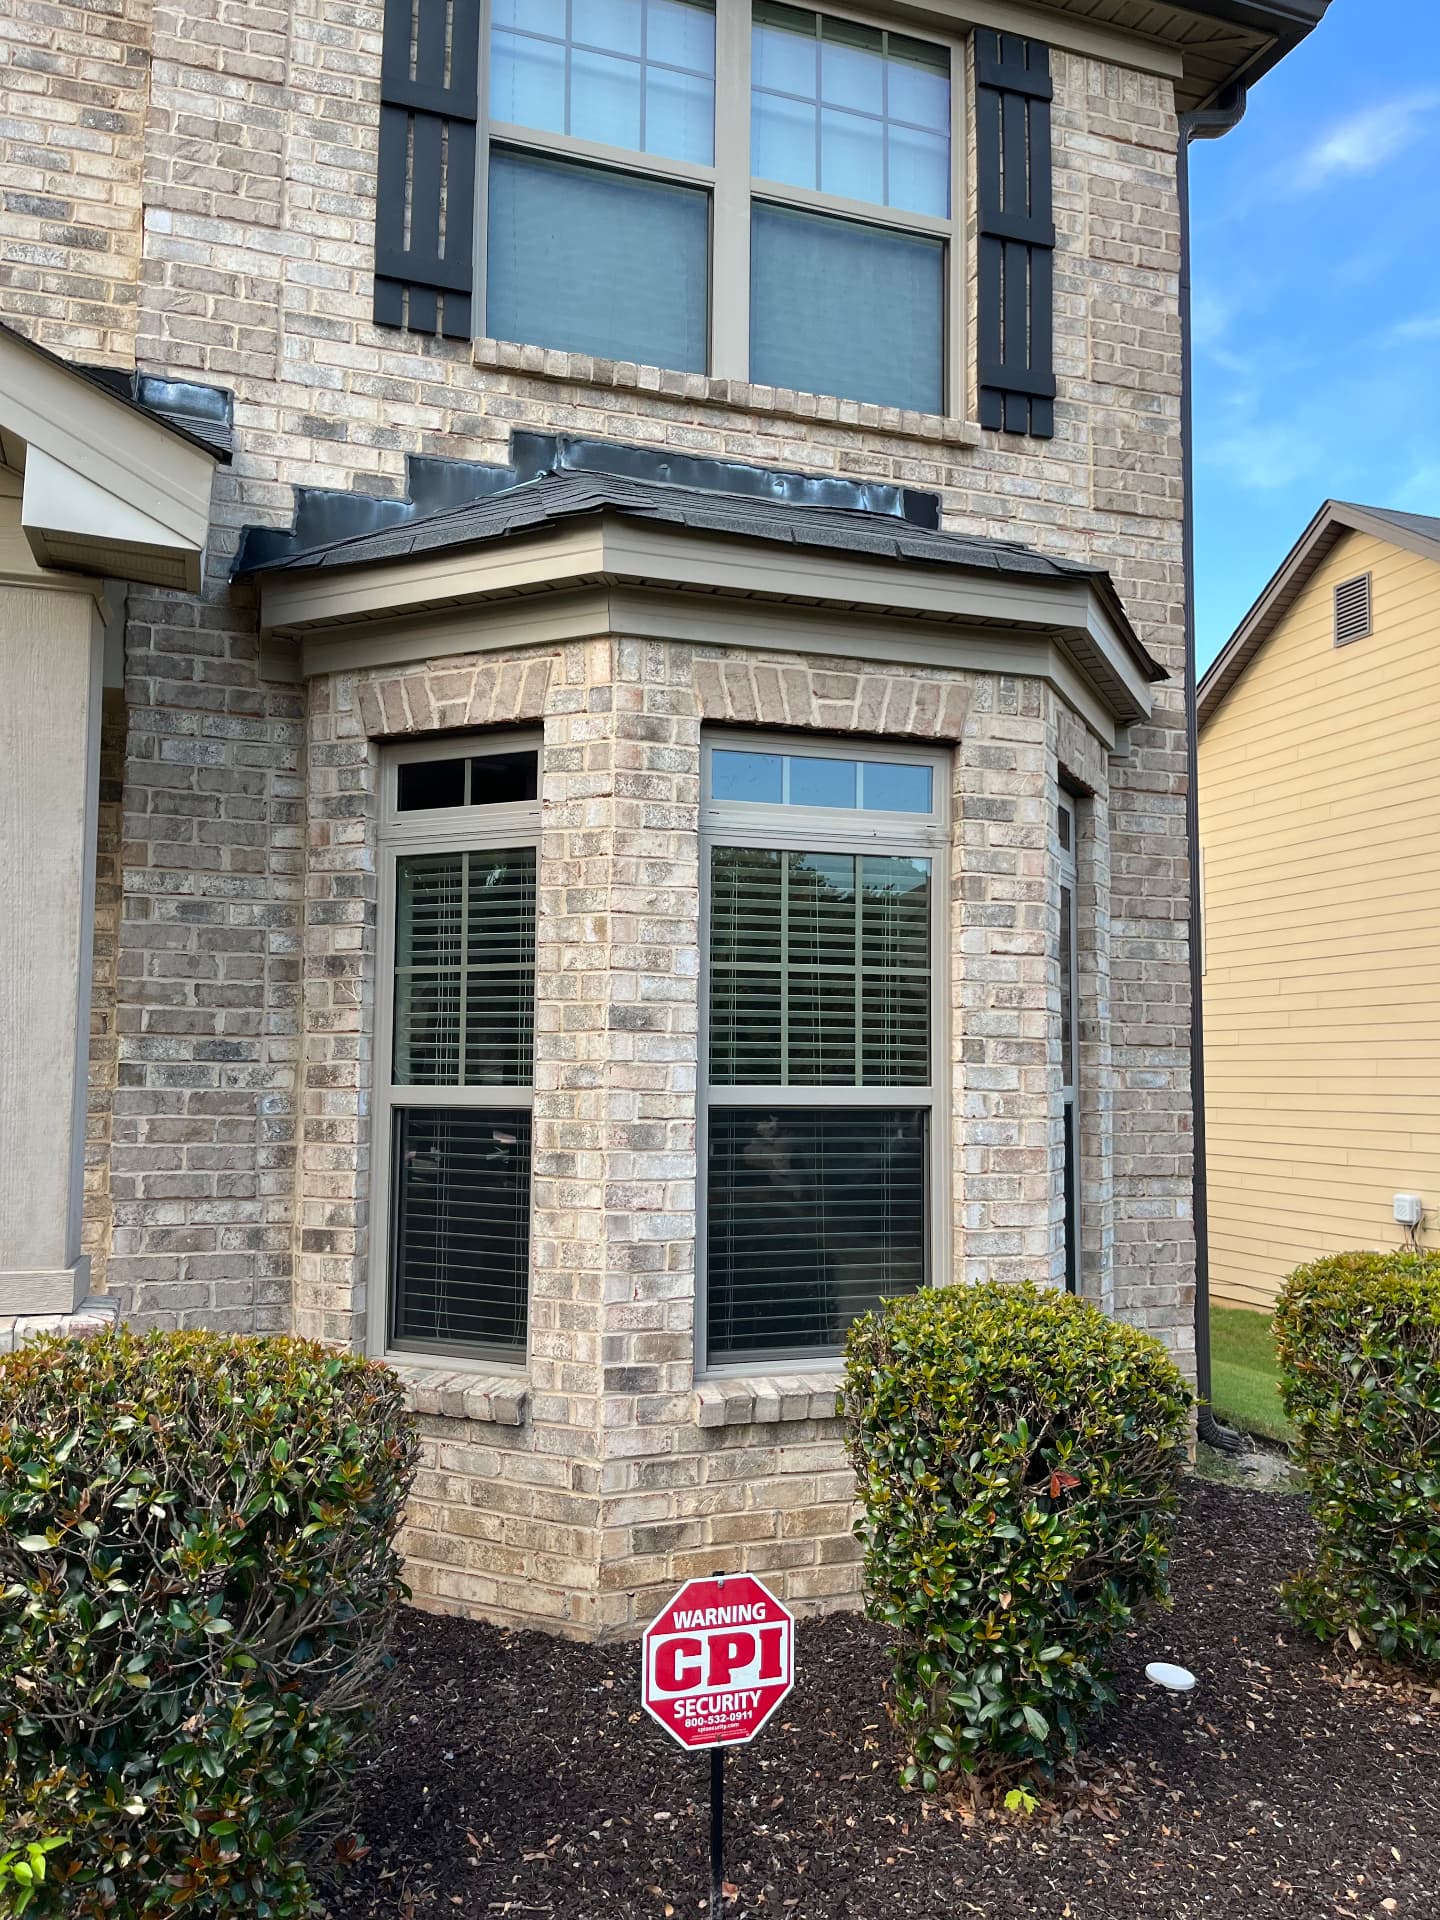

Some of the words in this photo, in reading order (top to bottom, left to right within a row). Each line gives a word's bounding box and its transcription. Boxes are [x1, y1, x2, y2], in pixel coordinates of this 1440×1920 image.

[673, 1602, 766, 1629] WARNING
[655, 1627, 783, 1692] CPI
[673, 1690, 762, 1718] SECURITY
[685, 1710, 752, 1727] 800-532-0911
